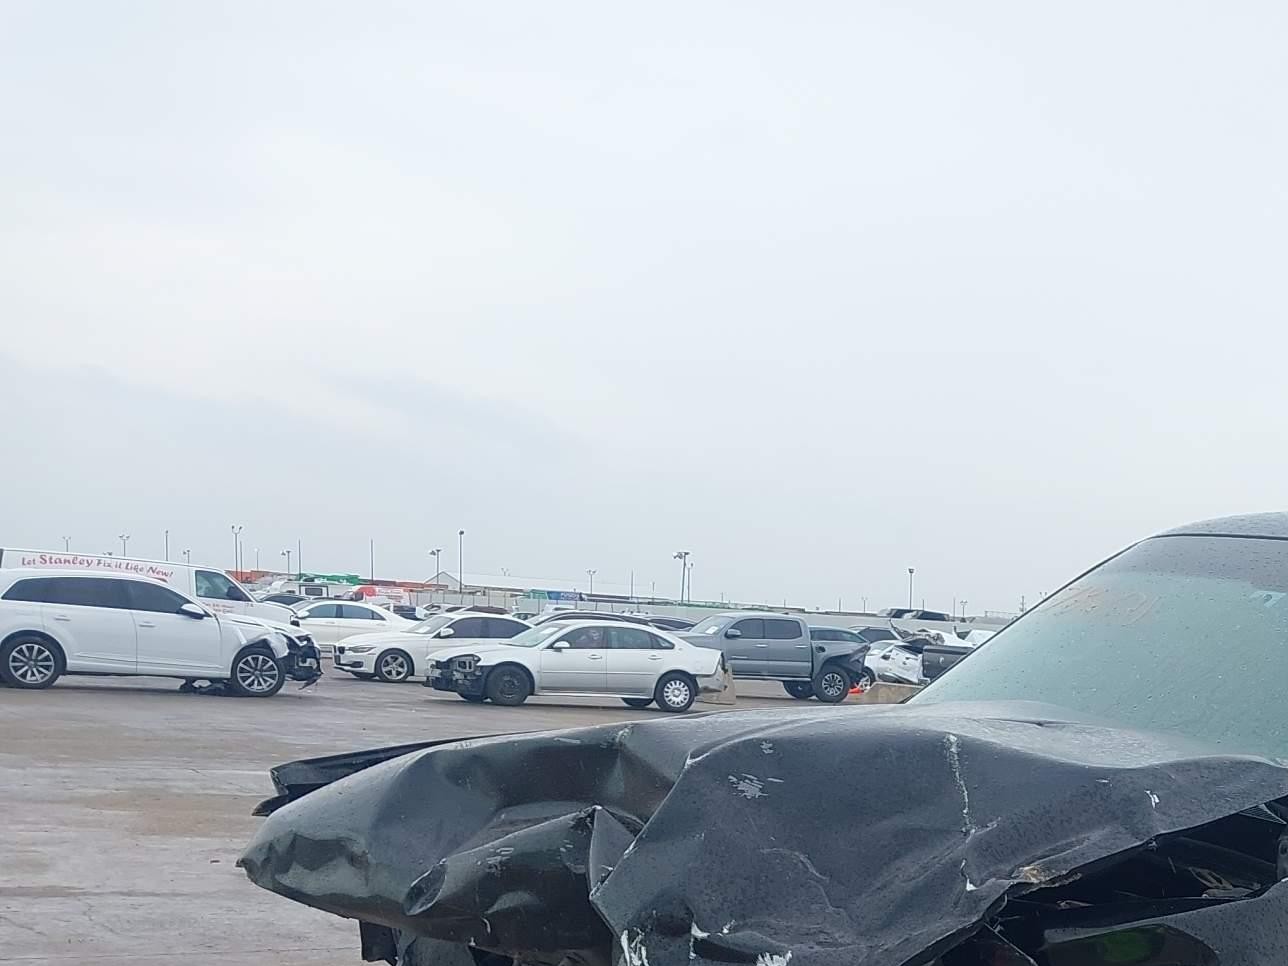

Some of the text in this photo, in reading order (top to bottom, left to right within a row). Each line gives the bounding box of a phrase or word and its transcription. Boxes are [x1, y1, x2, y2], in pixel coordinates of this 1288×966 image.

[22, 554, 174, 577] Let Stanley Fix it Like New!
